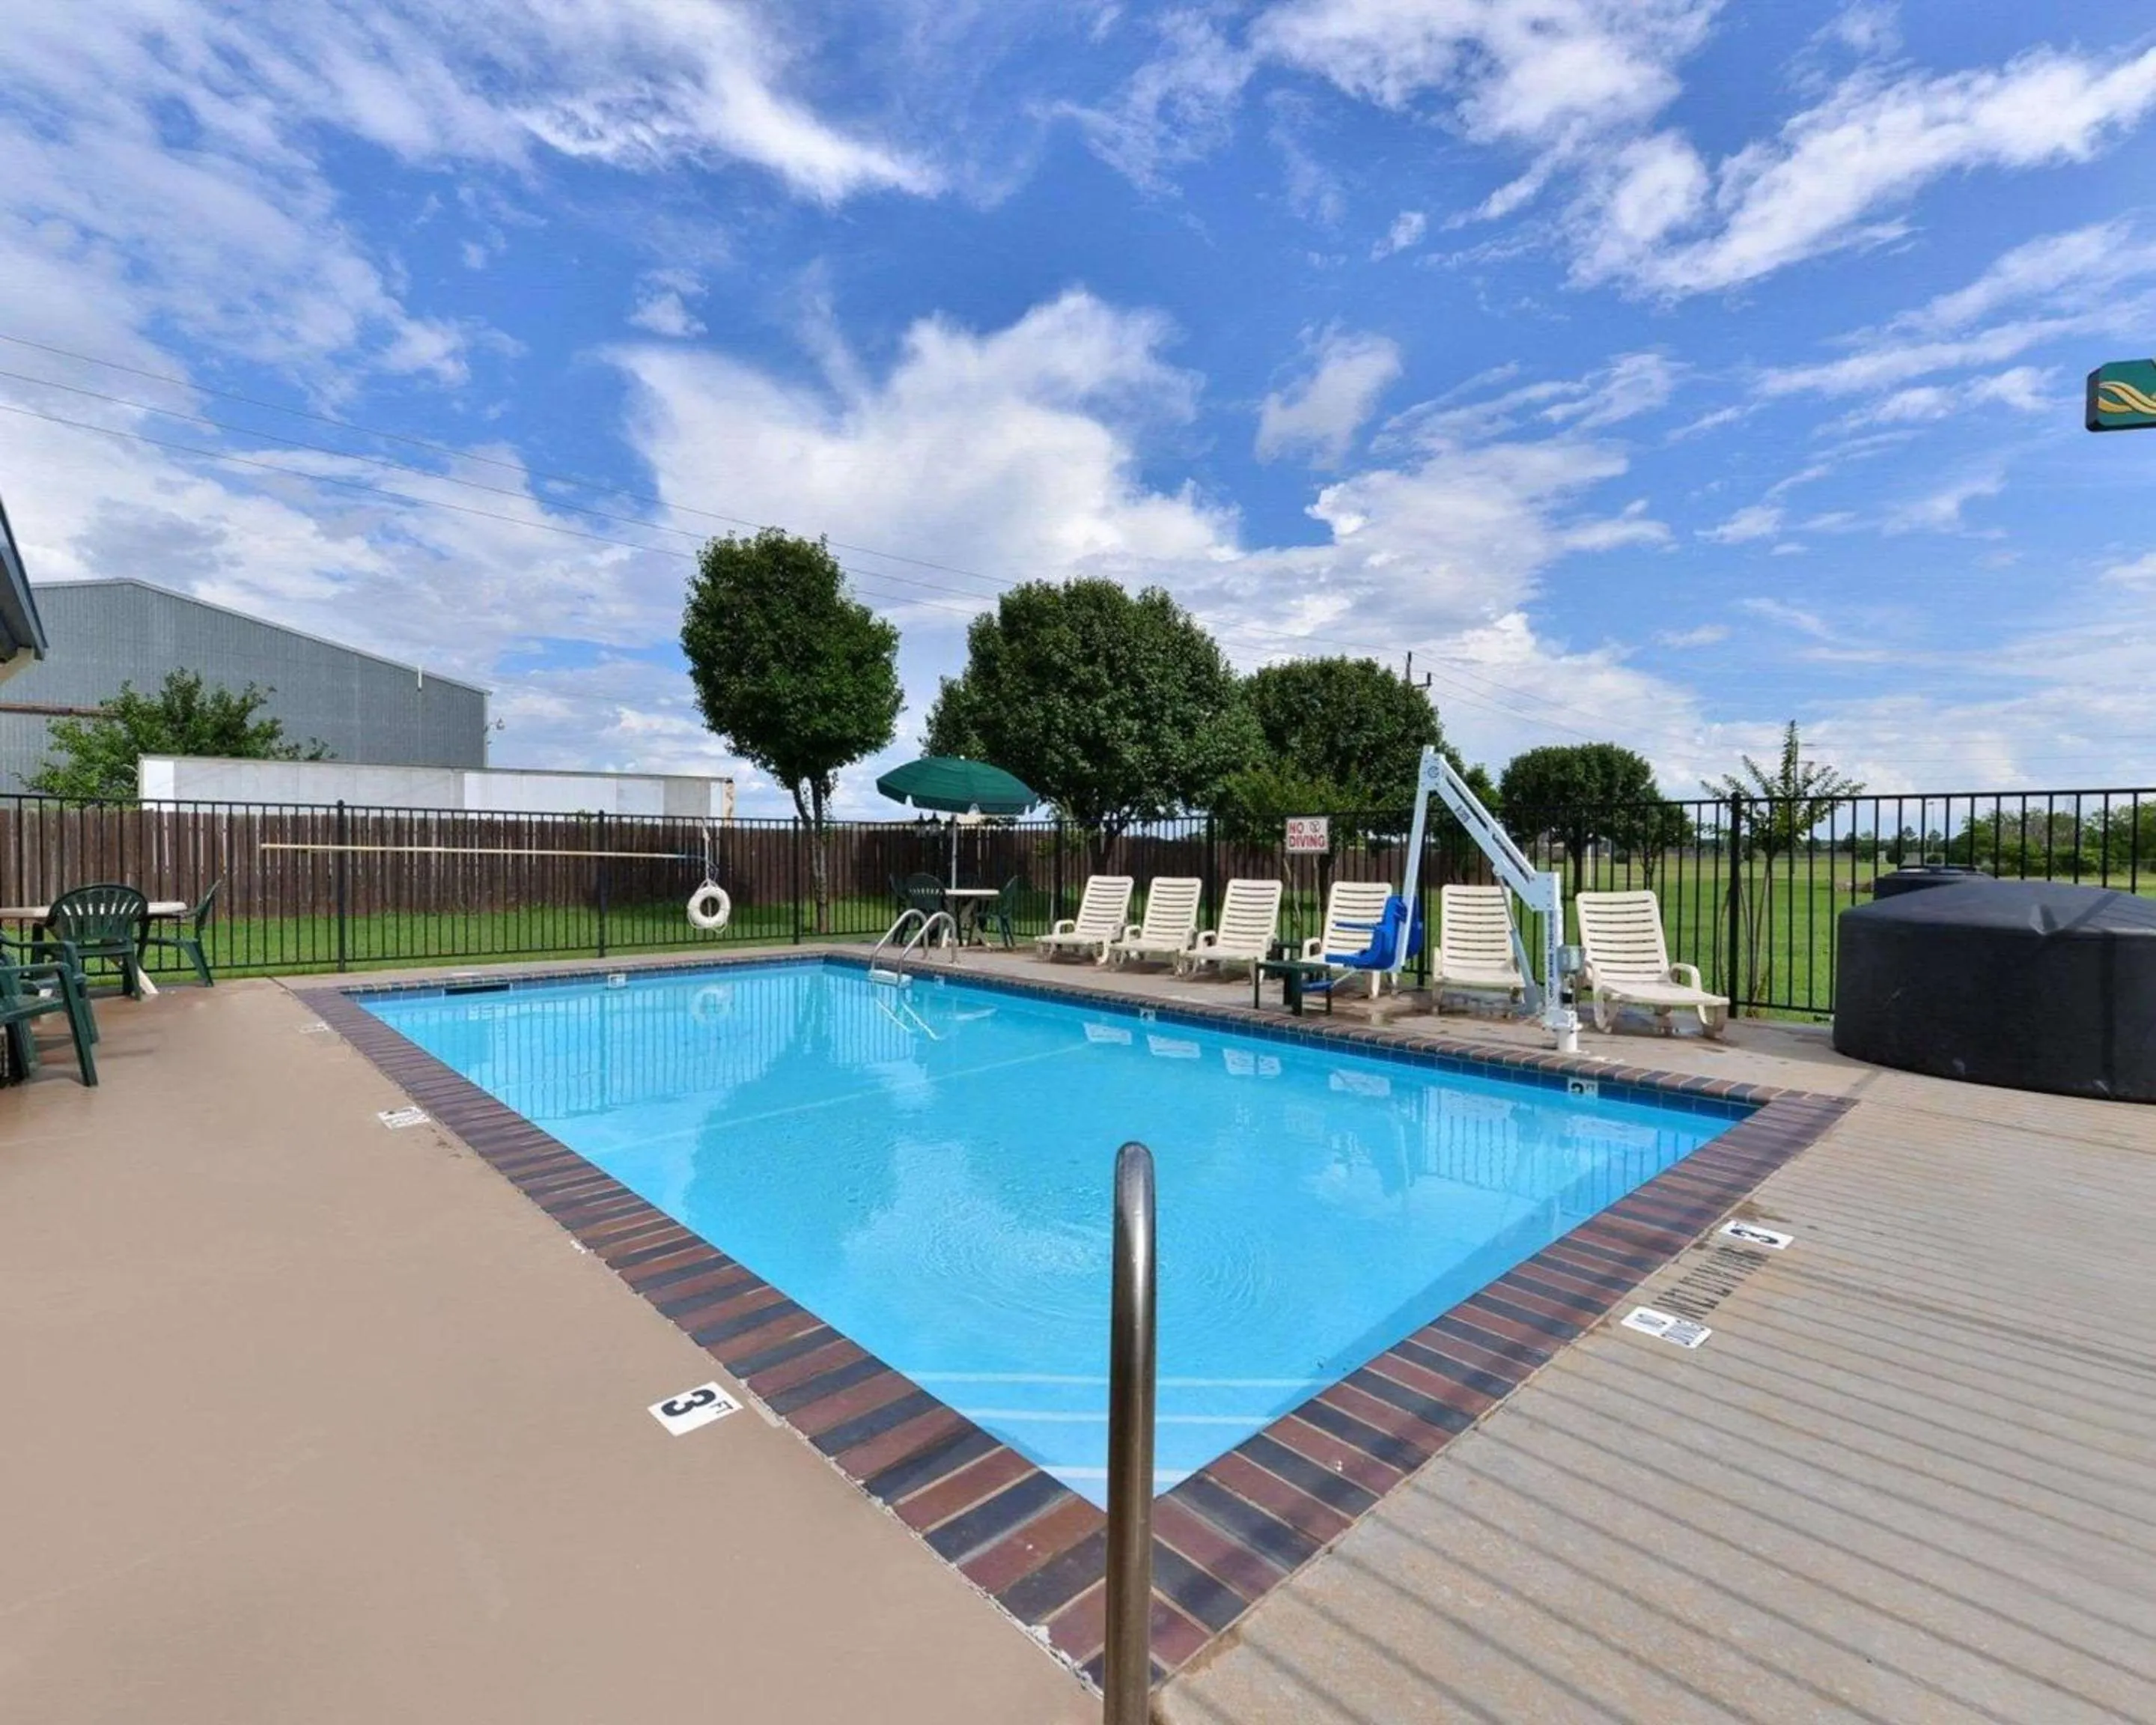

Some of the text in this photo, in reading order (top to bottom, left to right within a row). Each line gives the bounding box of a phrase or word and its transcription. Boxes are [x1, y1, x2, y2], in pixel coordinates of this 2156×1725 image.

[1289, 822, 1304, 834] NO
[1289, 834, 1324, 848] DIVING
[1729, 1228, 1779, 1244] 3
[660, 1389, 716, 1417] 3
